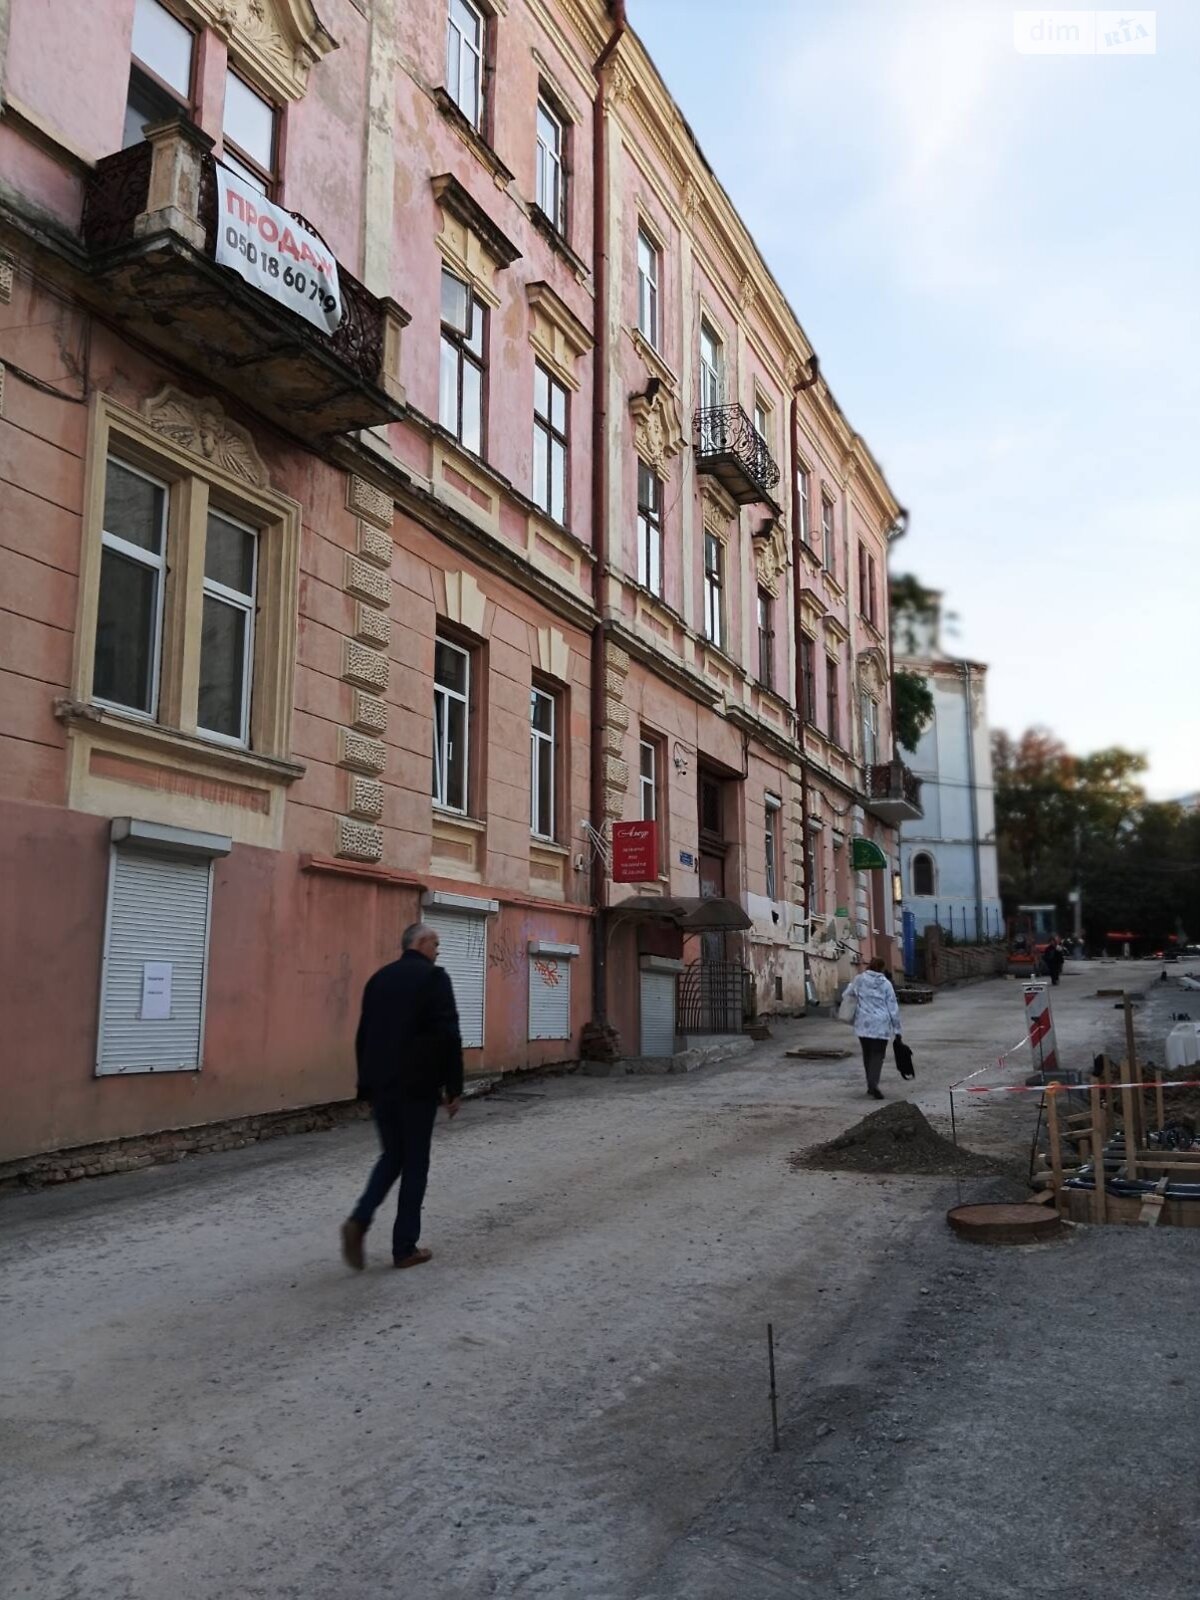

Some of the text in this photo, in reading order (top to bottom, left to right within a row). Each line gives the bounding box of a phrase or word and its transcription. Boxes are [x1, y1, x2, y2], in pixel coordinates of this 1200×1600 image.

[226, 227, 257, 264] 050
[261, 251, 279, 278] 18
[283, 266, 306, 294] 60
